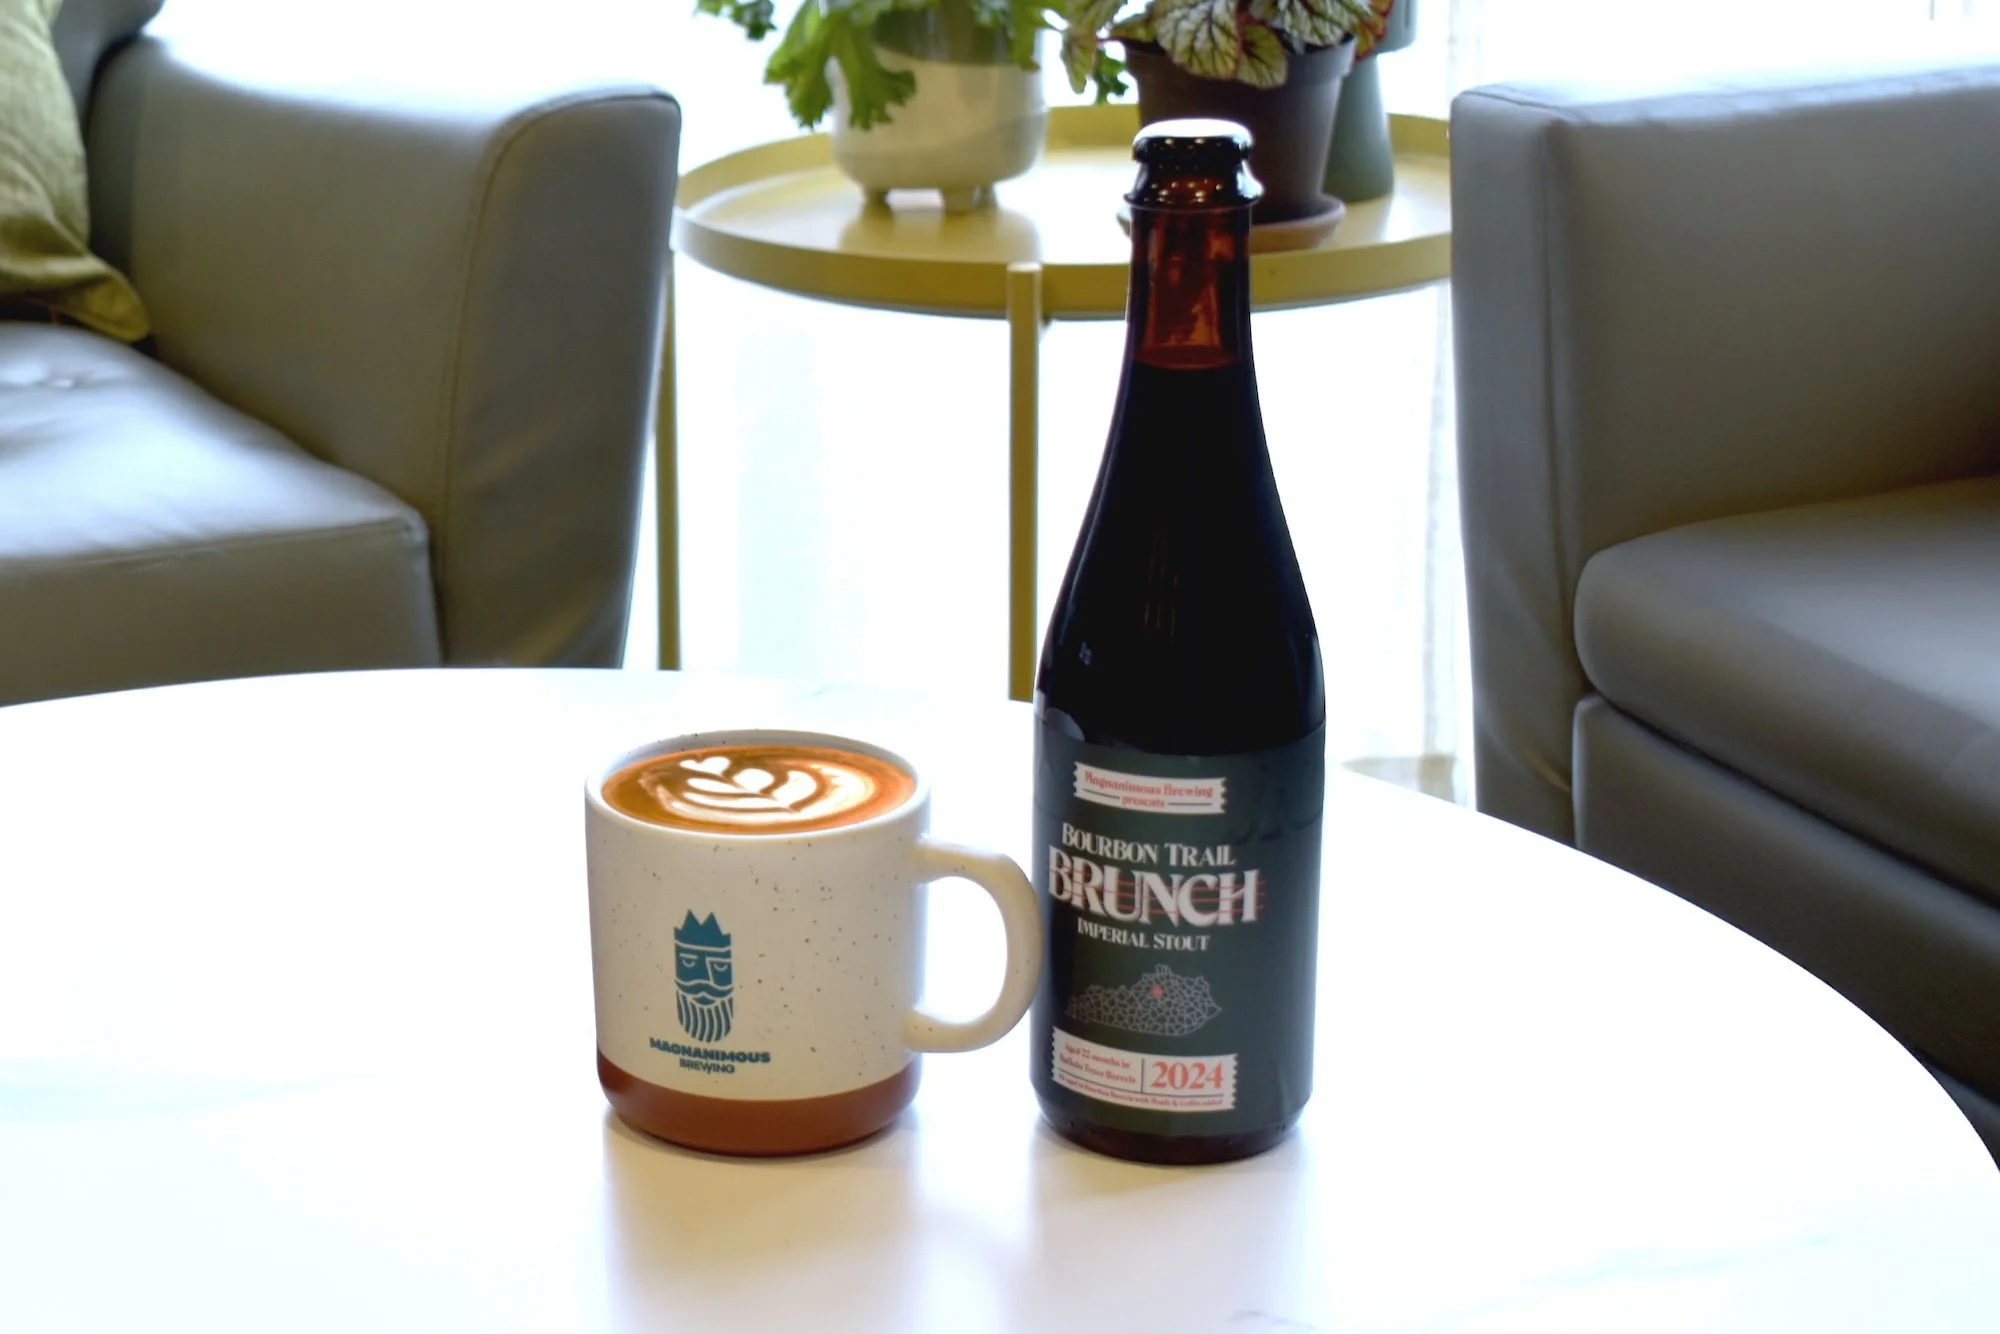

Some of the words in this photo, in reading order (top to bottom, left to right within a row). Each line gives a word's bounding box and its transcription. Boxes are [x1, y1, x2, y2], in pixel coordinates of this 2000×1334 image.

[1084, 770, 1162, 796] Magnanimous
[1164, 783, 1213, 799] Brewing
[1121, 796, 1166, 809] presents
[1062, 821, 1159, 864] BOURBON
[1164, 842, 1236, 867] TRAIL
[1048, 846, 1260, 927] BRUNCH
[1077, 916, 1149, 949] IMPERIAL
[1153, 933, 1211, 951] STOUT
[649, 1036, 771, 1063] MAGNANIMOUS
[679, 1058, 736, 1074] BREWING
[1151, 1060, 1224, 1090] 2024
